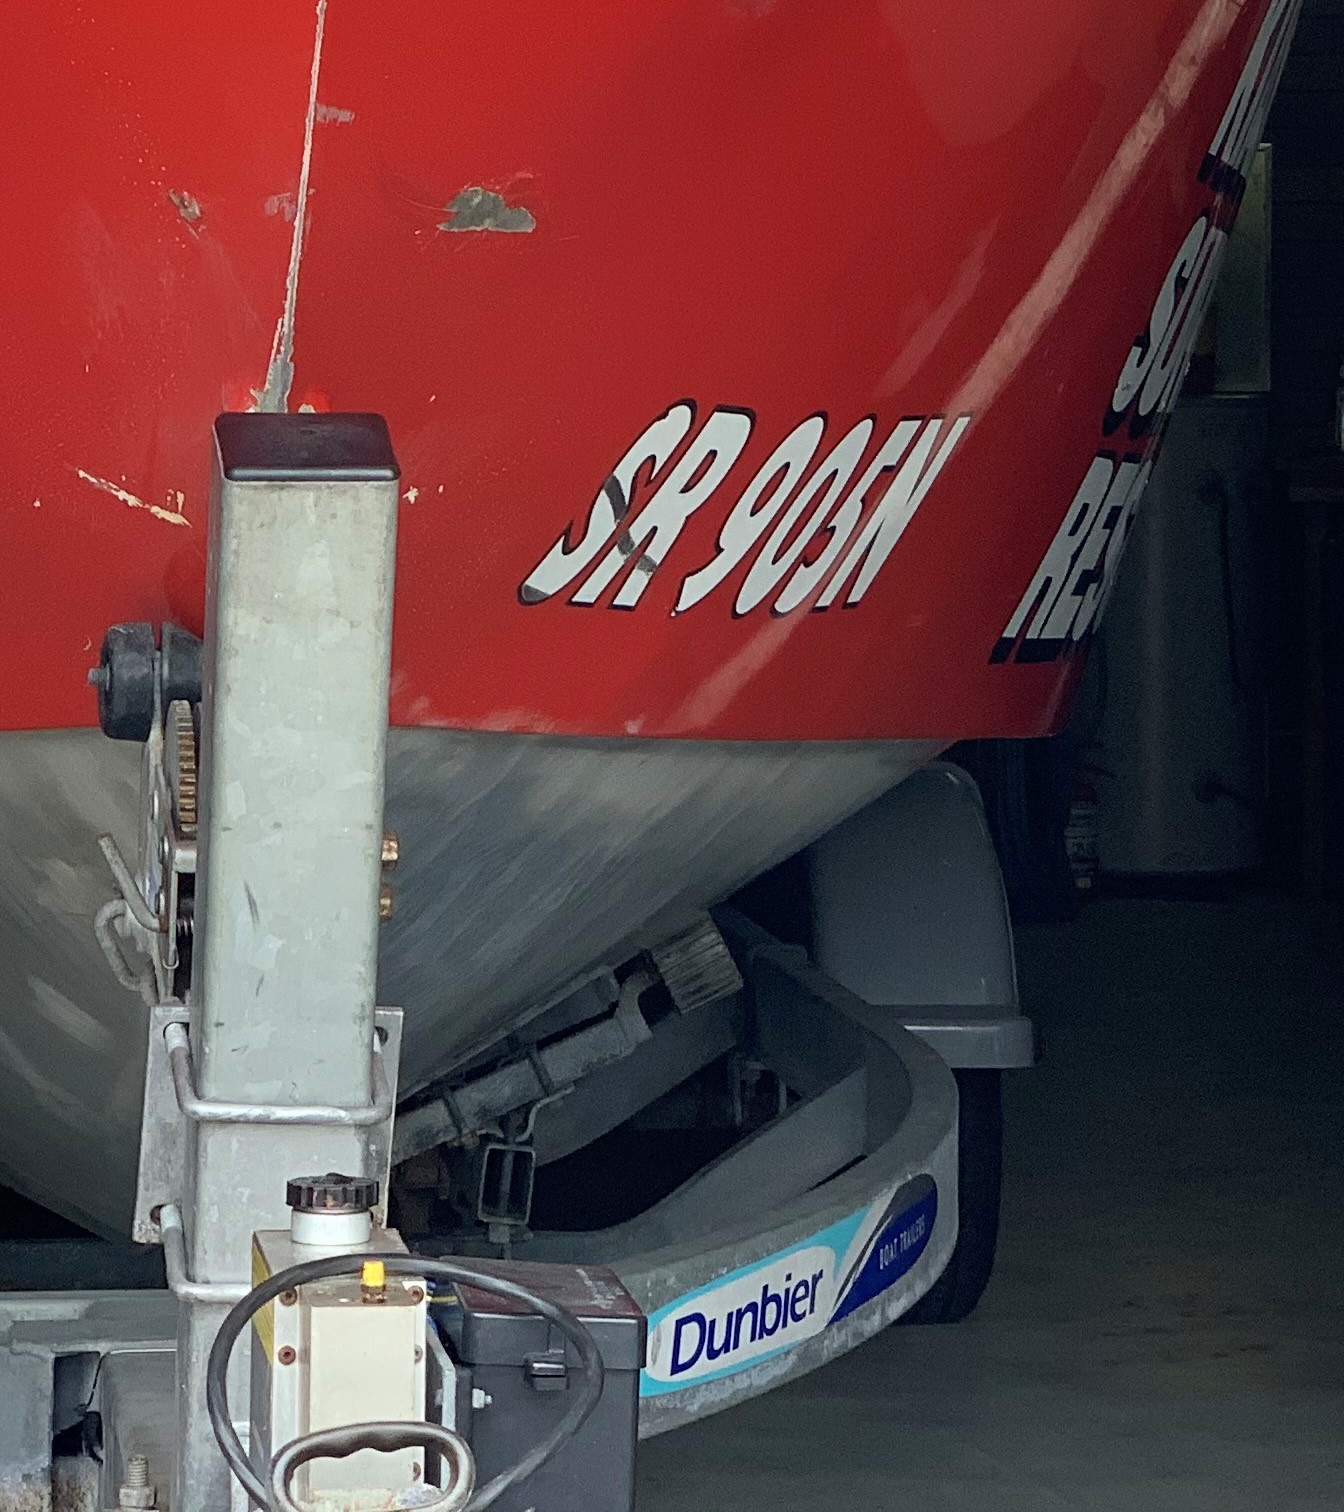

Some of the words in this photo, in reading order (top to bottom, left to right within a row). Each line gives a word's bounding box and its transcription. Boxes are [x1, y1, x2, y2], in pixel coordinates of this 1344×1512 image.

[517, 398, 756, 609] SR
[670, 410, 975, 620] 905N
[669, 1268, 824, 1377] Dunbier
